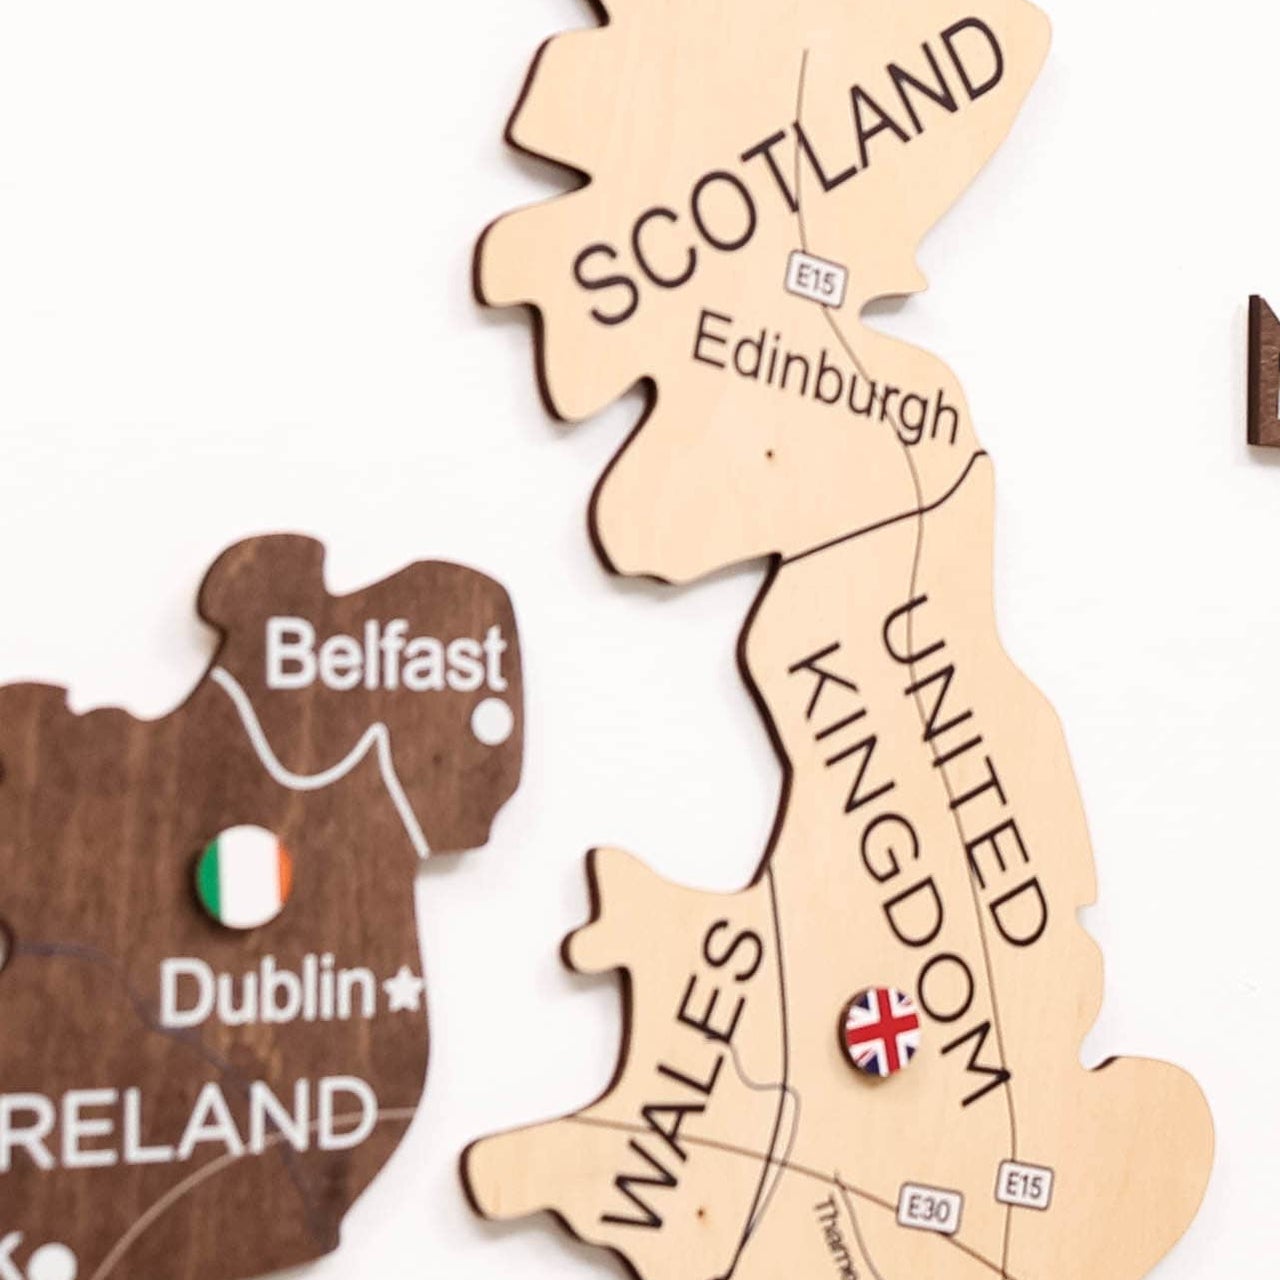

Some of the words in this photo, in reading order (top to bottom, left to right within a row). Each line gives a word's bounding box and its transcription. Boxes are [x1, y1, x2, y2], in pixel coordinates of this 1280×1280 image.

[572, 16, 1005, 327] SCOTLAND
[796, 262, 838, 298] E15
[692, 309, 960, 447] Edinburgh
[265, 616, 507, 692] Belfast
[882, 593, 1048, 947] UNITED
[788, 640, 1012, 1109] KINGDOM
[159, 953, 376, 1029] Dublin
[0, 1074, 379, 1174] RELAND
[600, 918, 764, 1231] WALES
[906, 1193, 953, 1223] E30
[1005, 1173, 1044, 1200] E15
